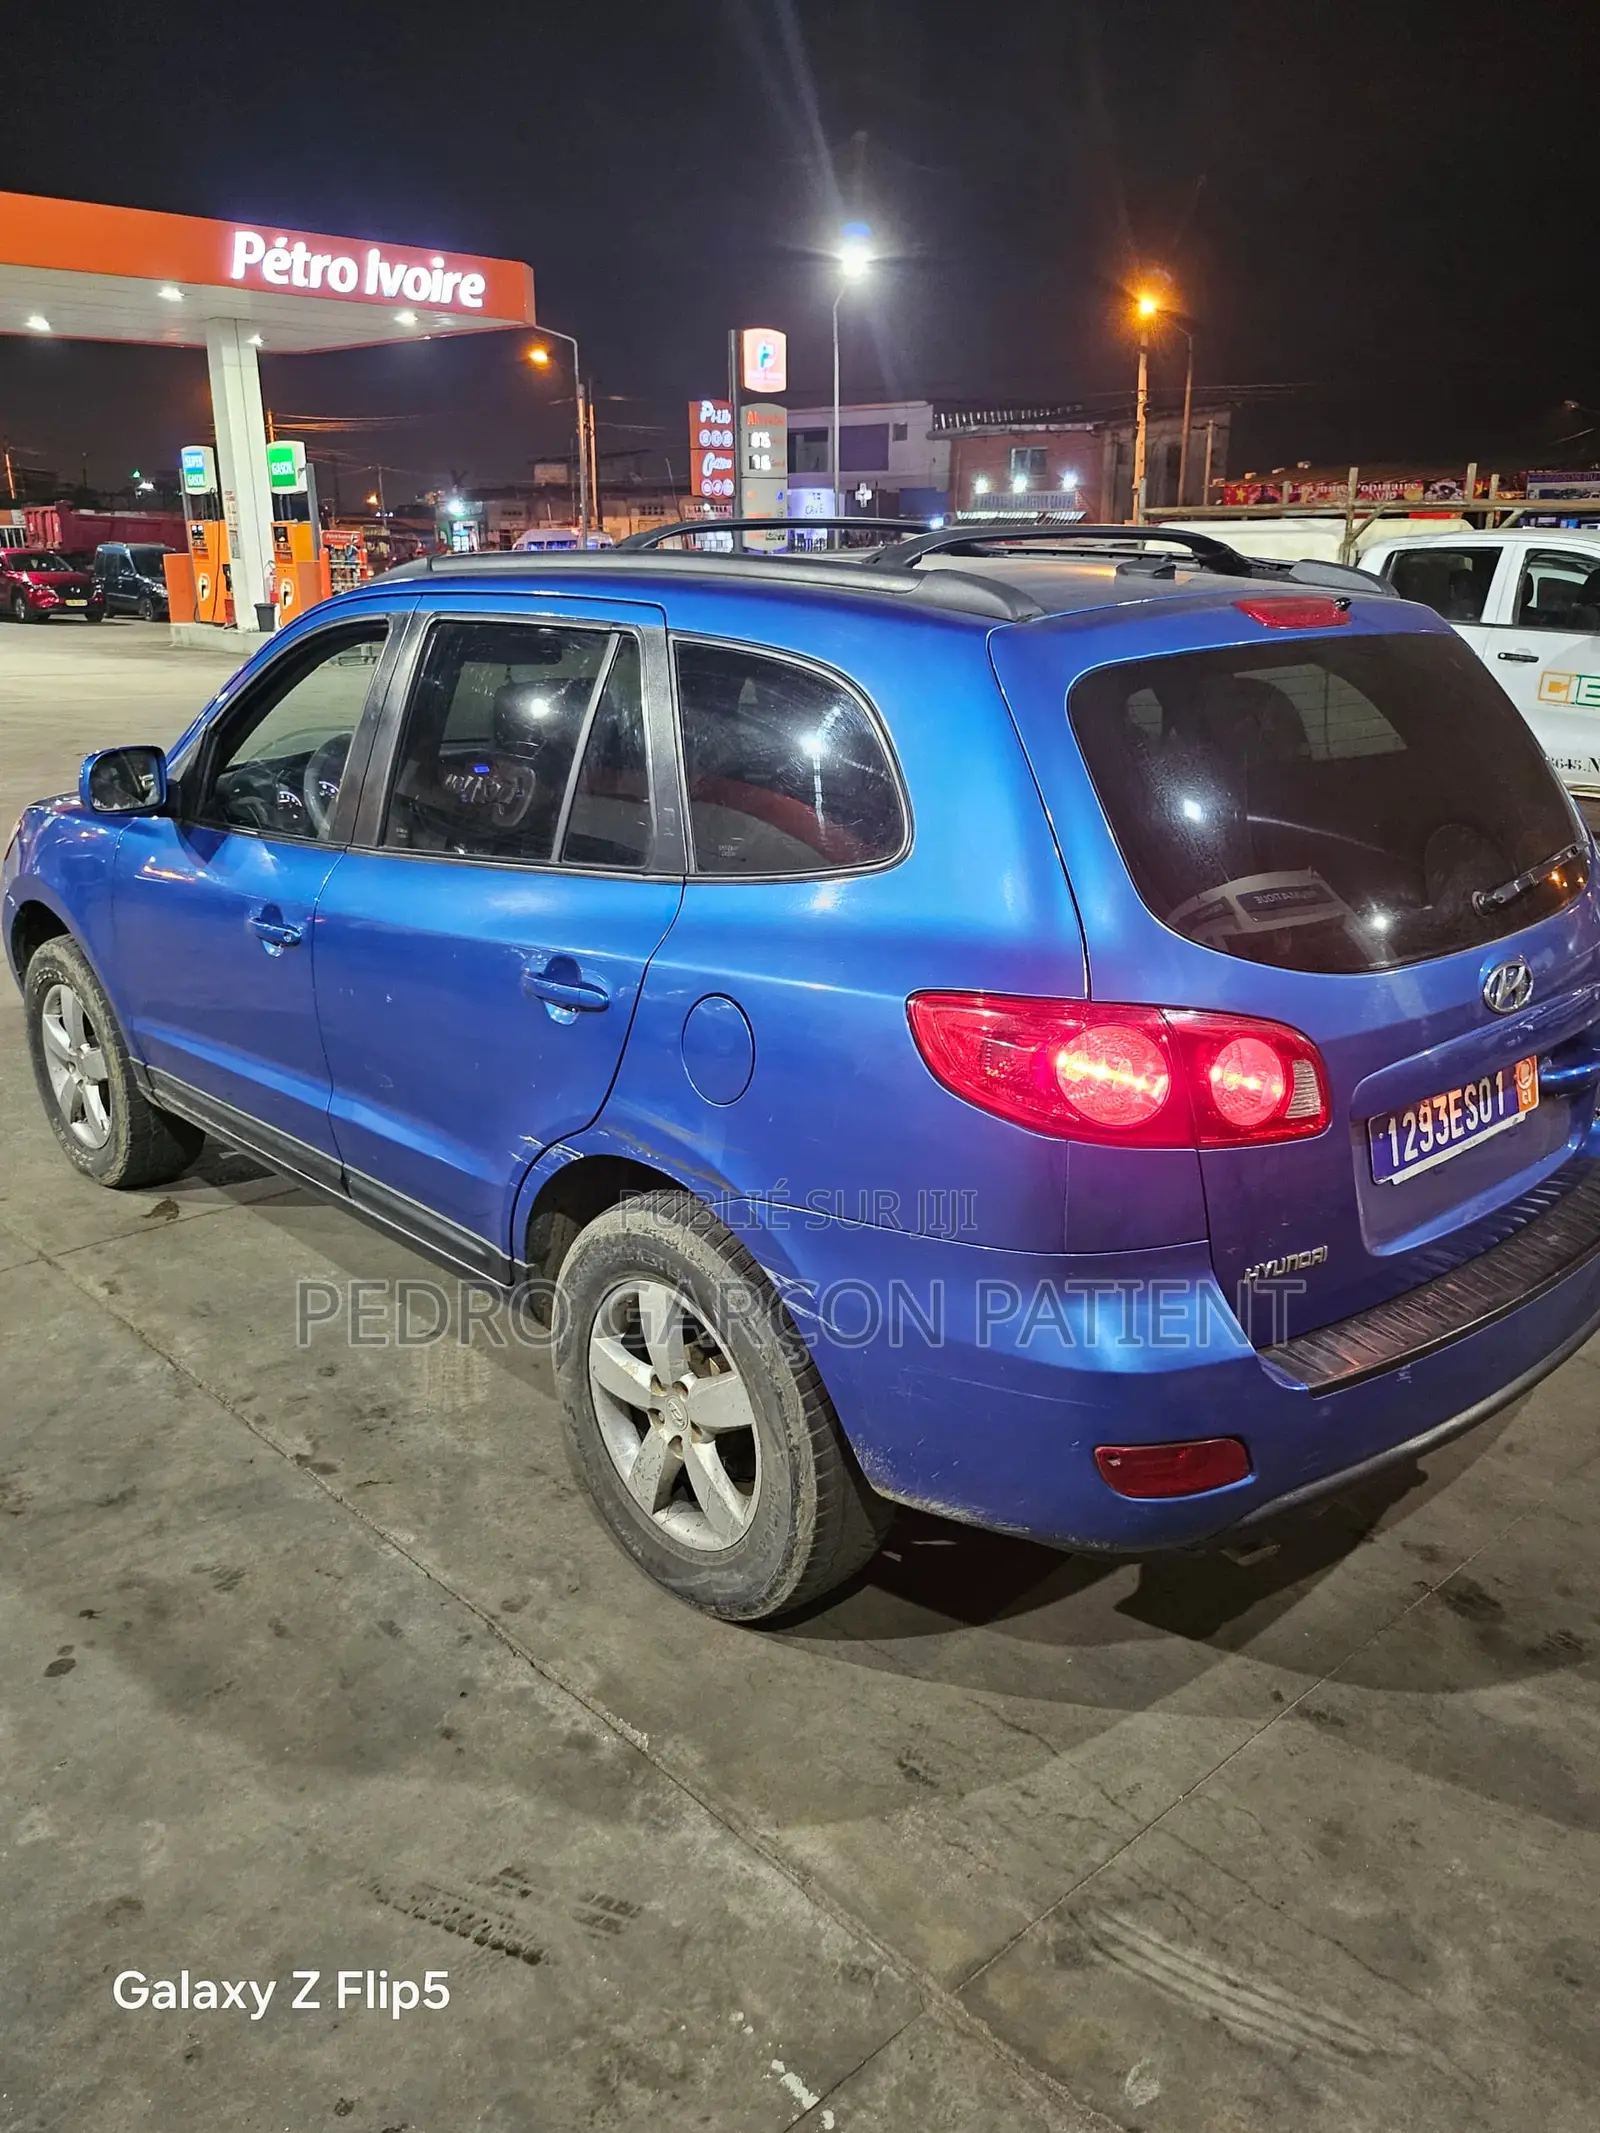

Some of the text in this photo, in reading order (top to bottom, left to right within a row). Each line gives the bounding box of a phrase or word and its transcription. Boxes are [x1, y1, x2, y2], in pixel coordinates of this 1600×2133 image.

[231, 231, 486, 308] Pétro Ivoire
[272, 461, 294, 475] GASOIL
[1388, 1071, 1503, 1167] 1293ES01
[1243, 1245, 1329, 1284] HYUNDAI
